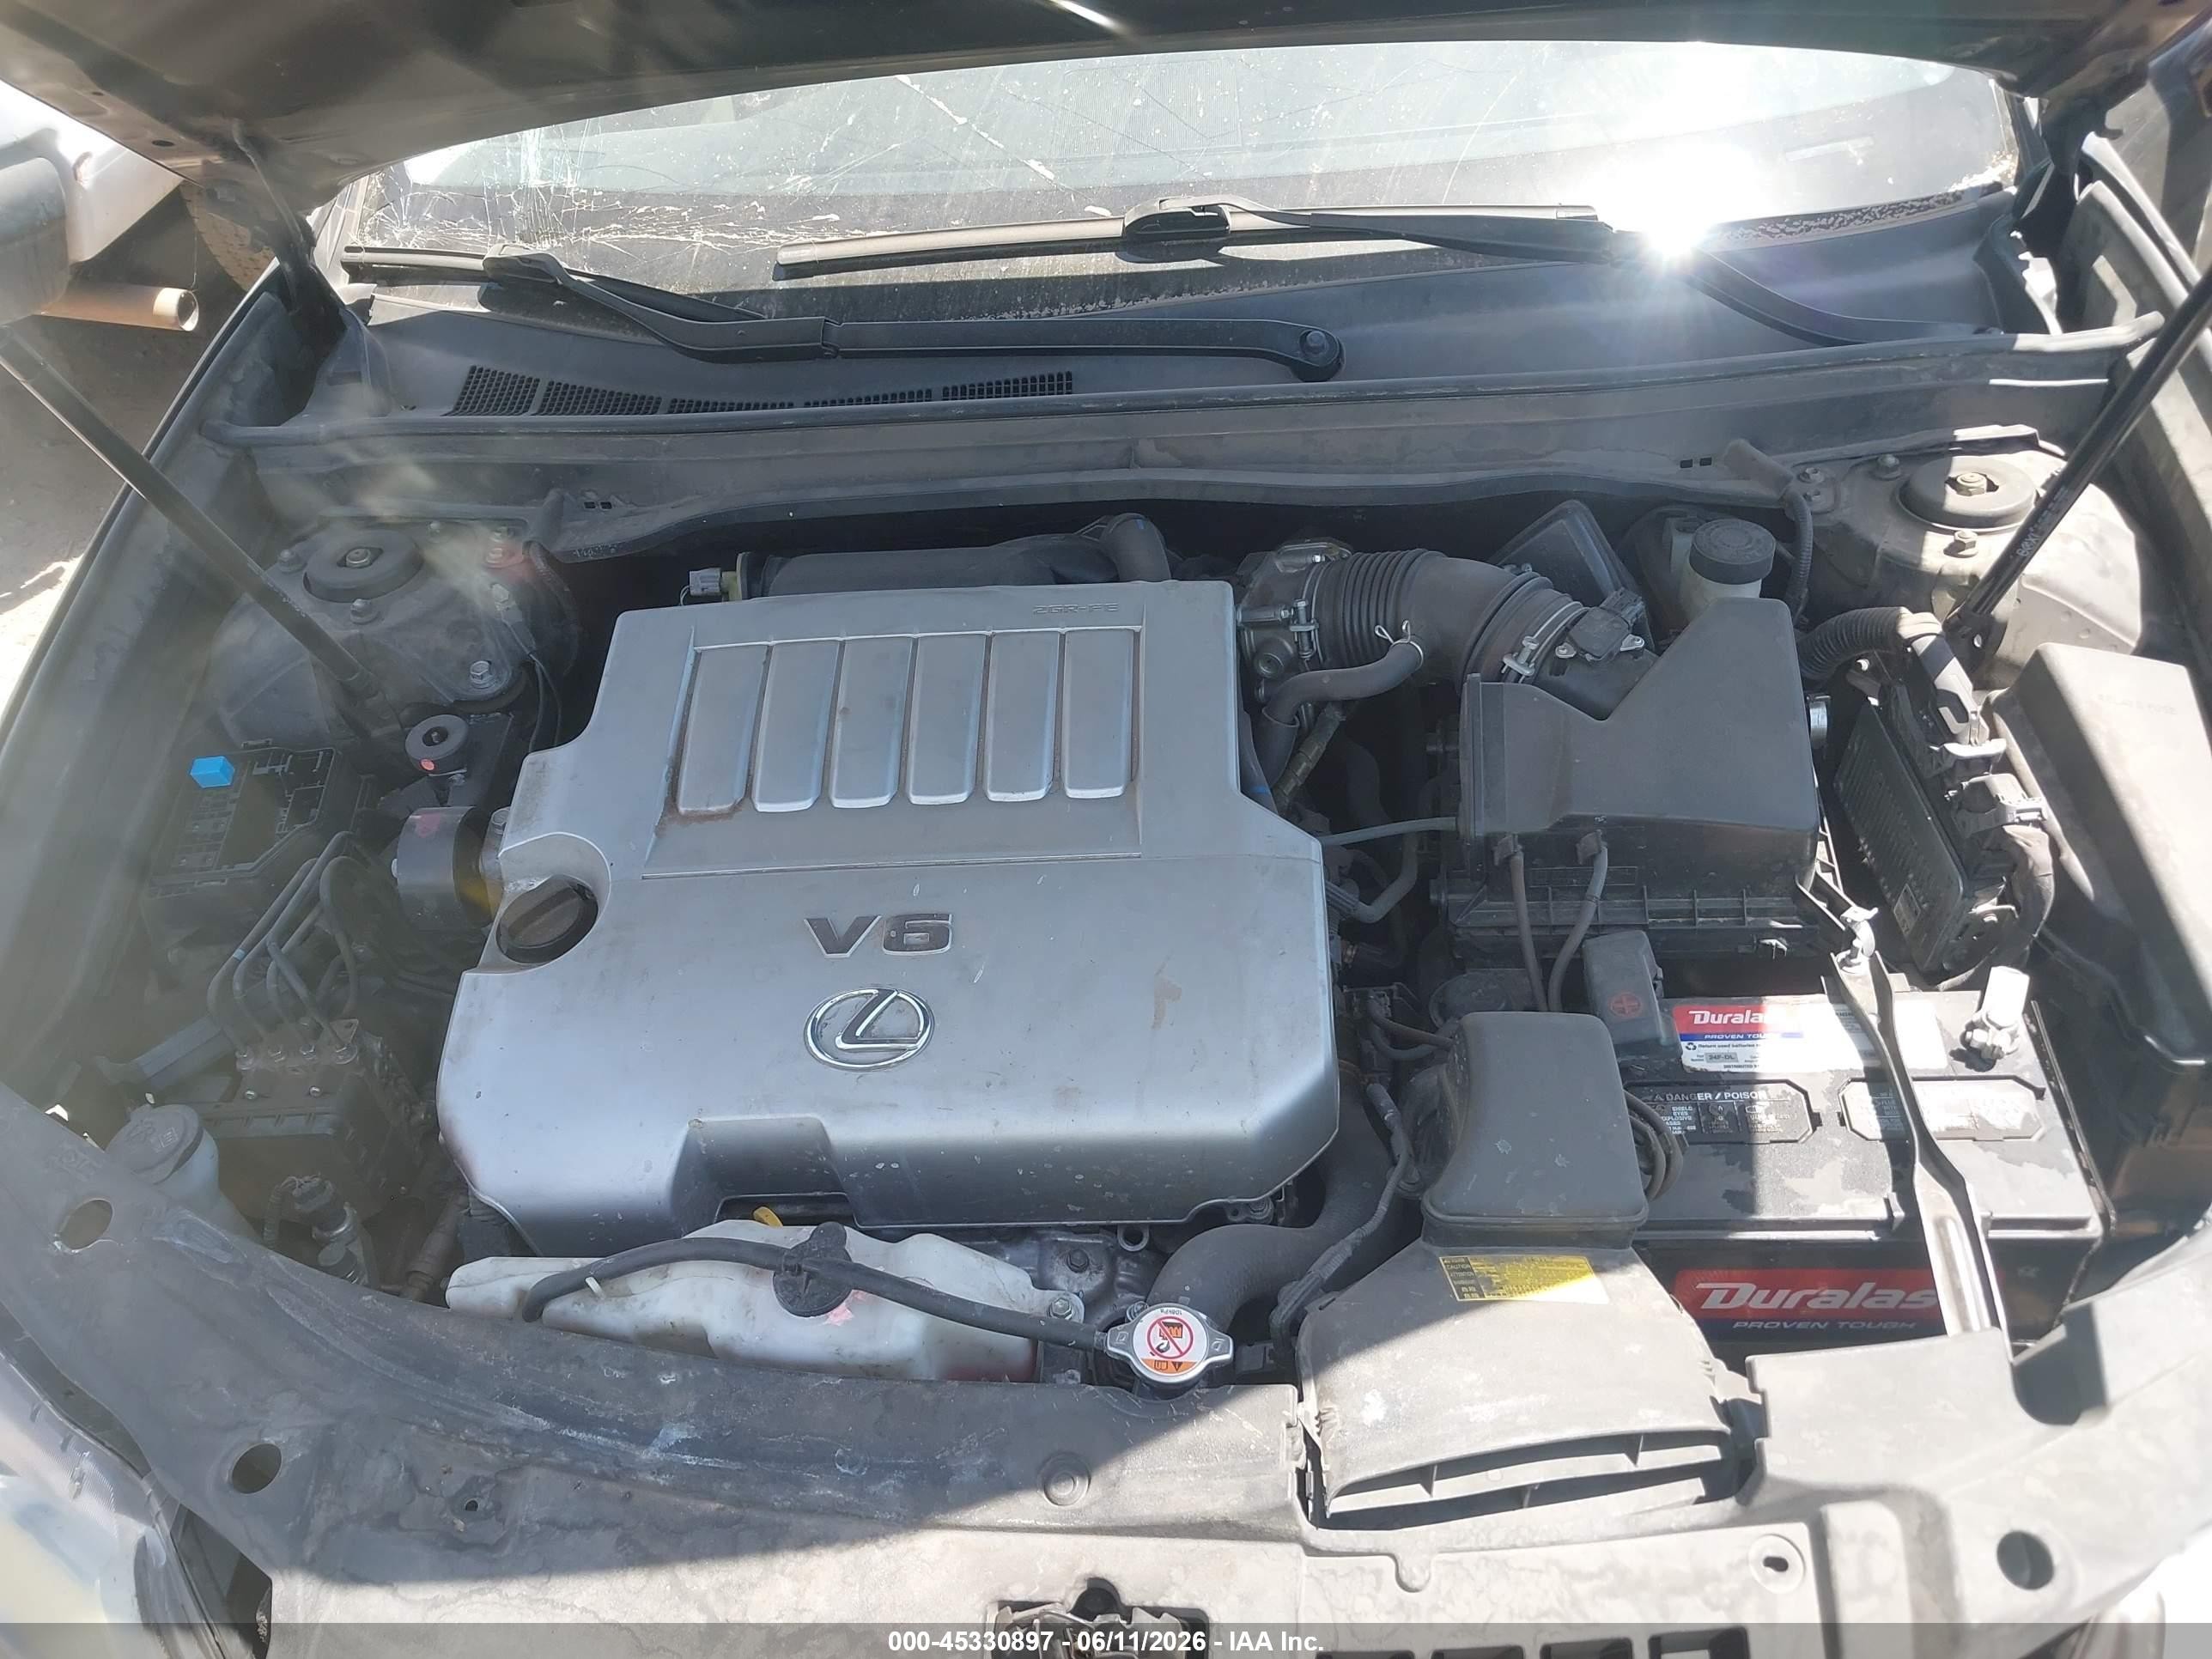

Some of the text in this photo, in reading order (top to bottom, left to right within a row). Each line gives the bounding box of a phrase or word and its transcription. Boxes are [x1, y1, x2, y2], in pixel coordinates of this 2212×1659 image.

[804, 913, 953, 957] V6
[1688, 1010, 1765, 1024] Durala
[1724, 1091, 1766, 1100] POISON
[1695, 1282, 1937, 1310] Duralas
[1732, 1321, 1917, 1329] PROVEN TOUGH
